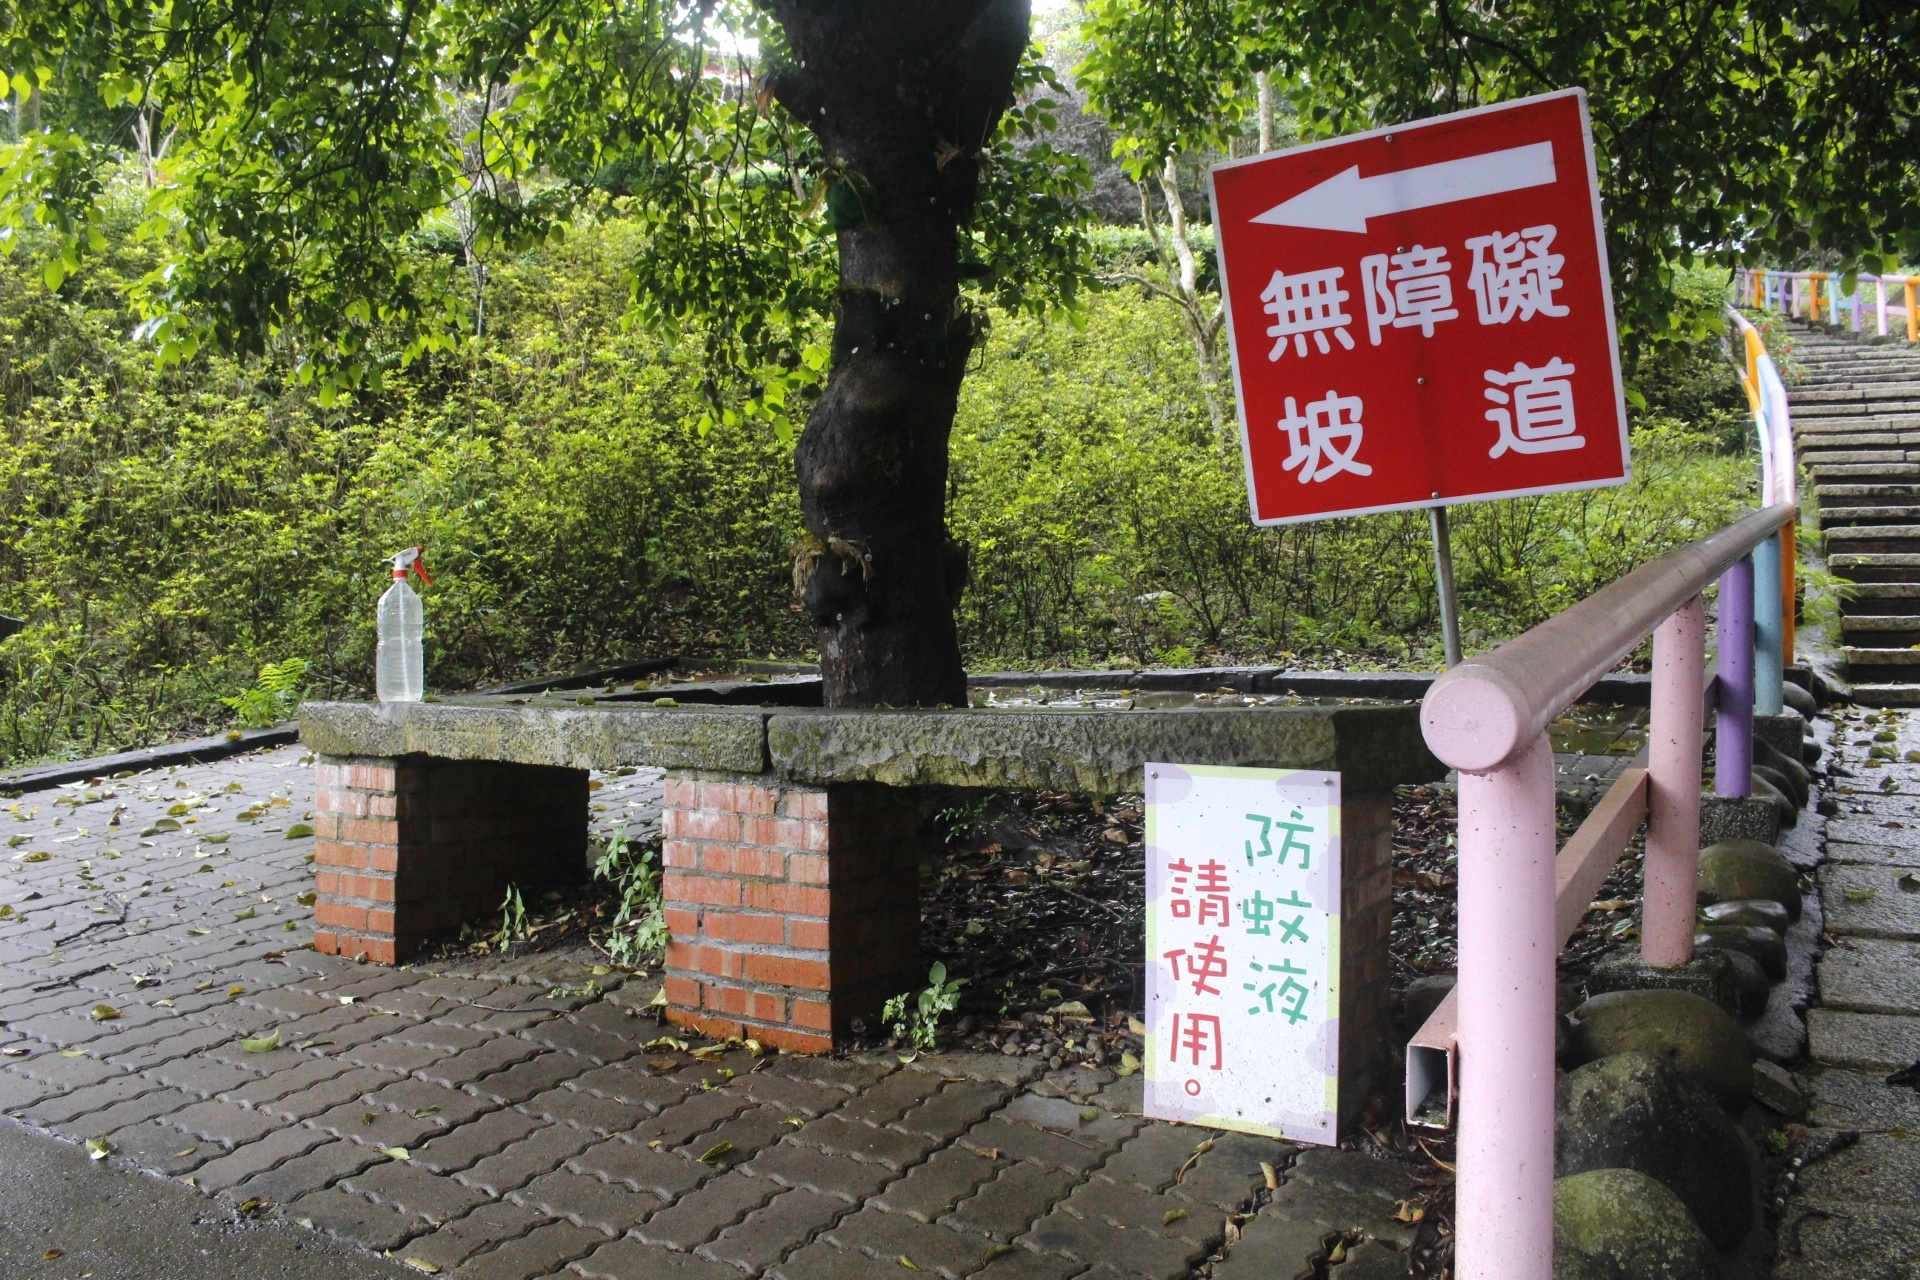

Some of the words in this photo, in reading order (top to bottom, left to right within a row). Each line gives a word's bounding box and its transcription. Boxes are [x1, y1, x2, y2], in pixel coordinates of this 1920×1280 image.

[1259, 223, 1571, 362] 無障礙
[1242, 810, 1315, 1026] 防蚊液
